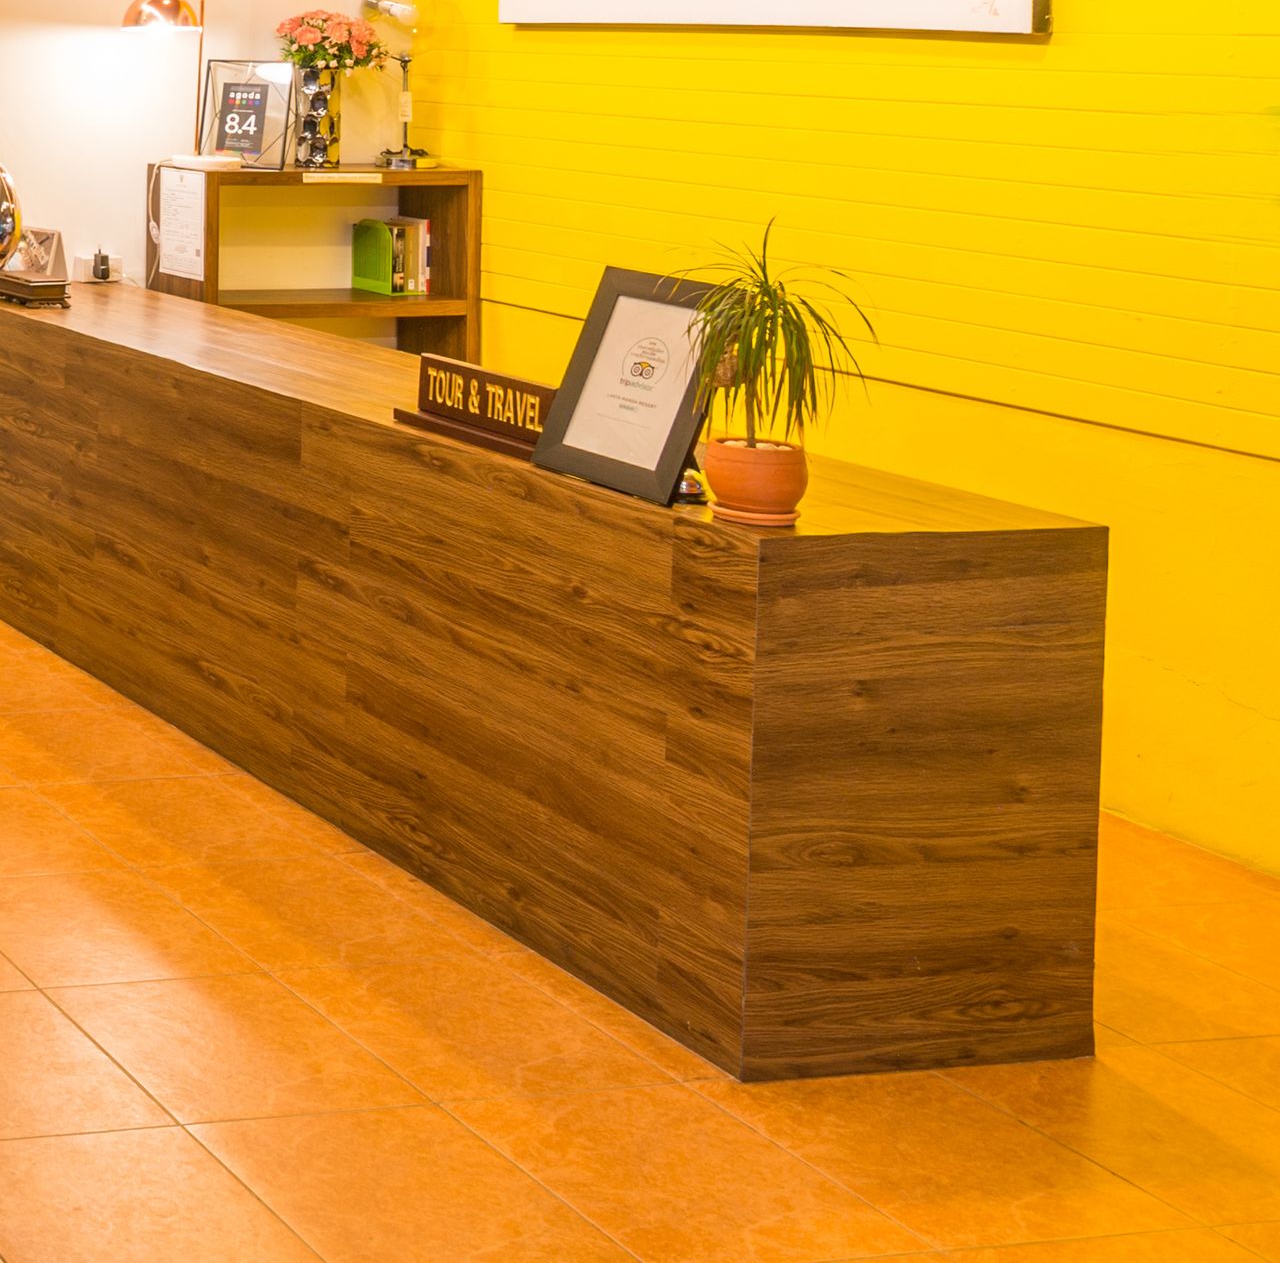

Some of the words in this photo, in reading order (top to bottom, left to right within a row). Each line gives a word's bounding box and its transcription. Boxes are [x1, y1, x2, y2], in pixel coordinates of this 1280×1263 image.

[229, 91, 261, 100] agoda
[224, 113, 258, 135] 8.4
[427, 366, 464, 410] TOUR
[468, 378, 480, 415] &
[486, 382, 543, 433] TRAVEL
